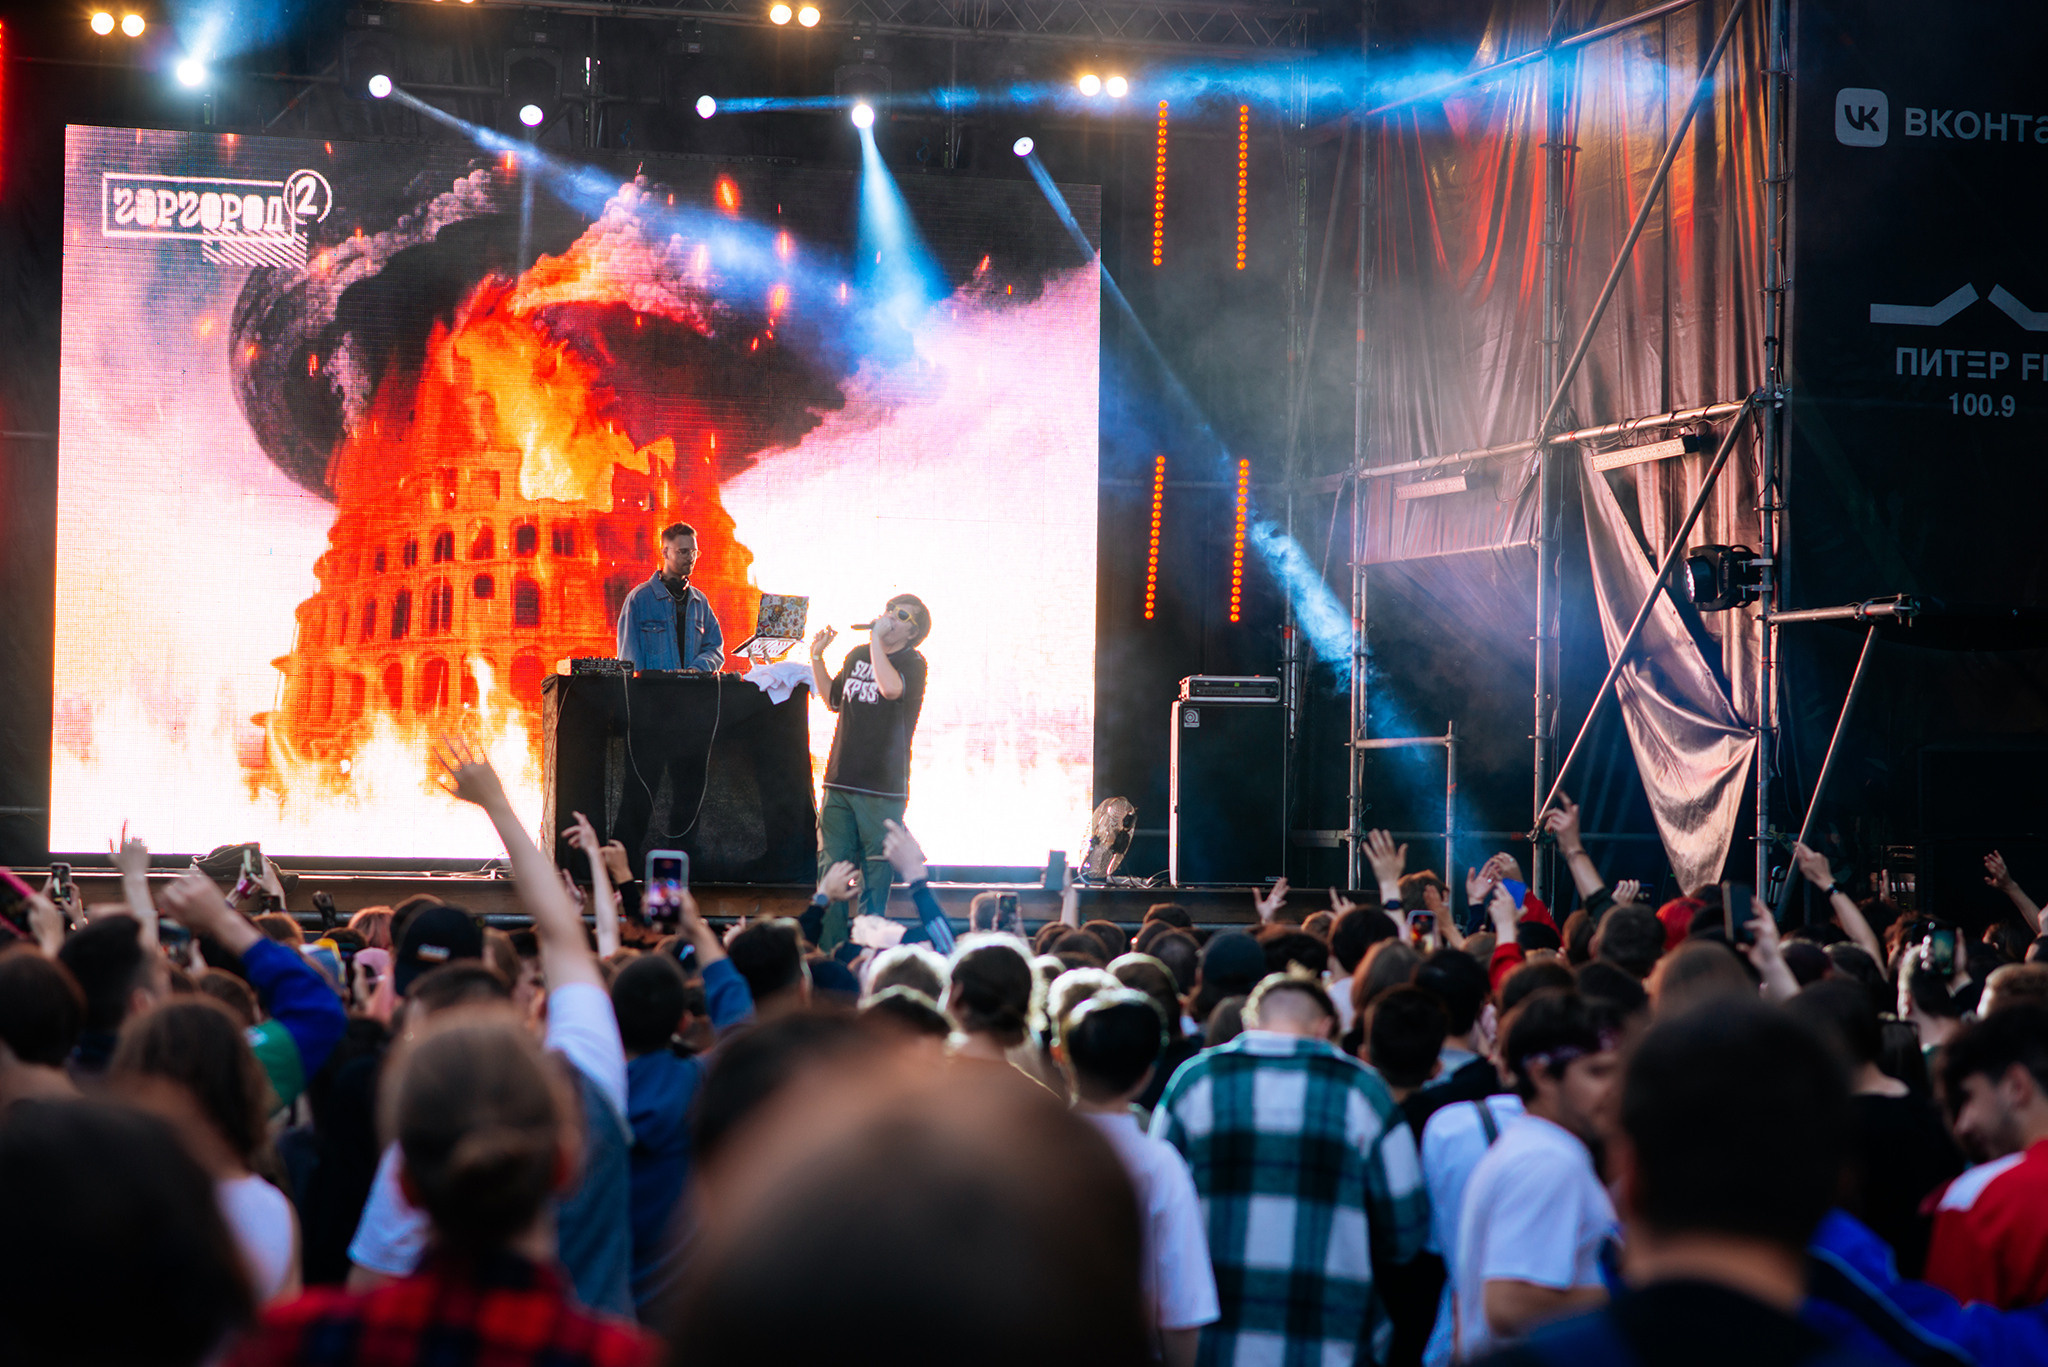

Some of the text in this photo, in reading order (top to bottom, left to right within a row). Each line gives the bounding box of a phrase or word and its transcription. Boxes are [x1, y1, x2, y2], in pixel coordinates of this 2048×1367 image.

[295, 175, 317, 215] 2
[1896, 347, 2048, 382] ПИТЕР F
[1949, 392, 2016, 418] 100.9
[842, 677, 880, 704] KPSS
